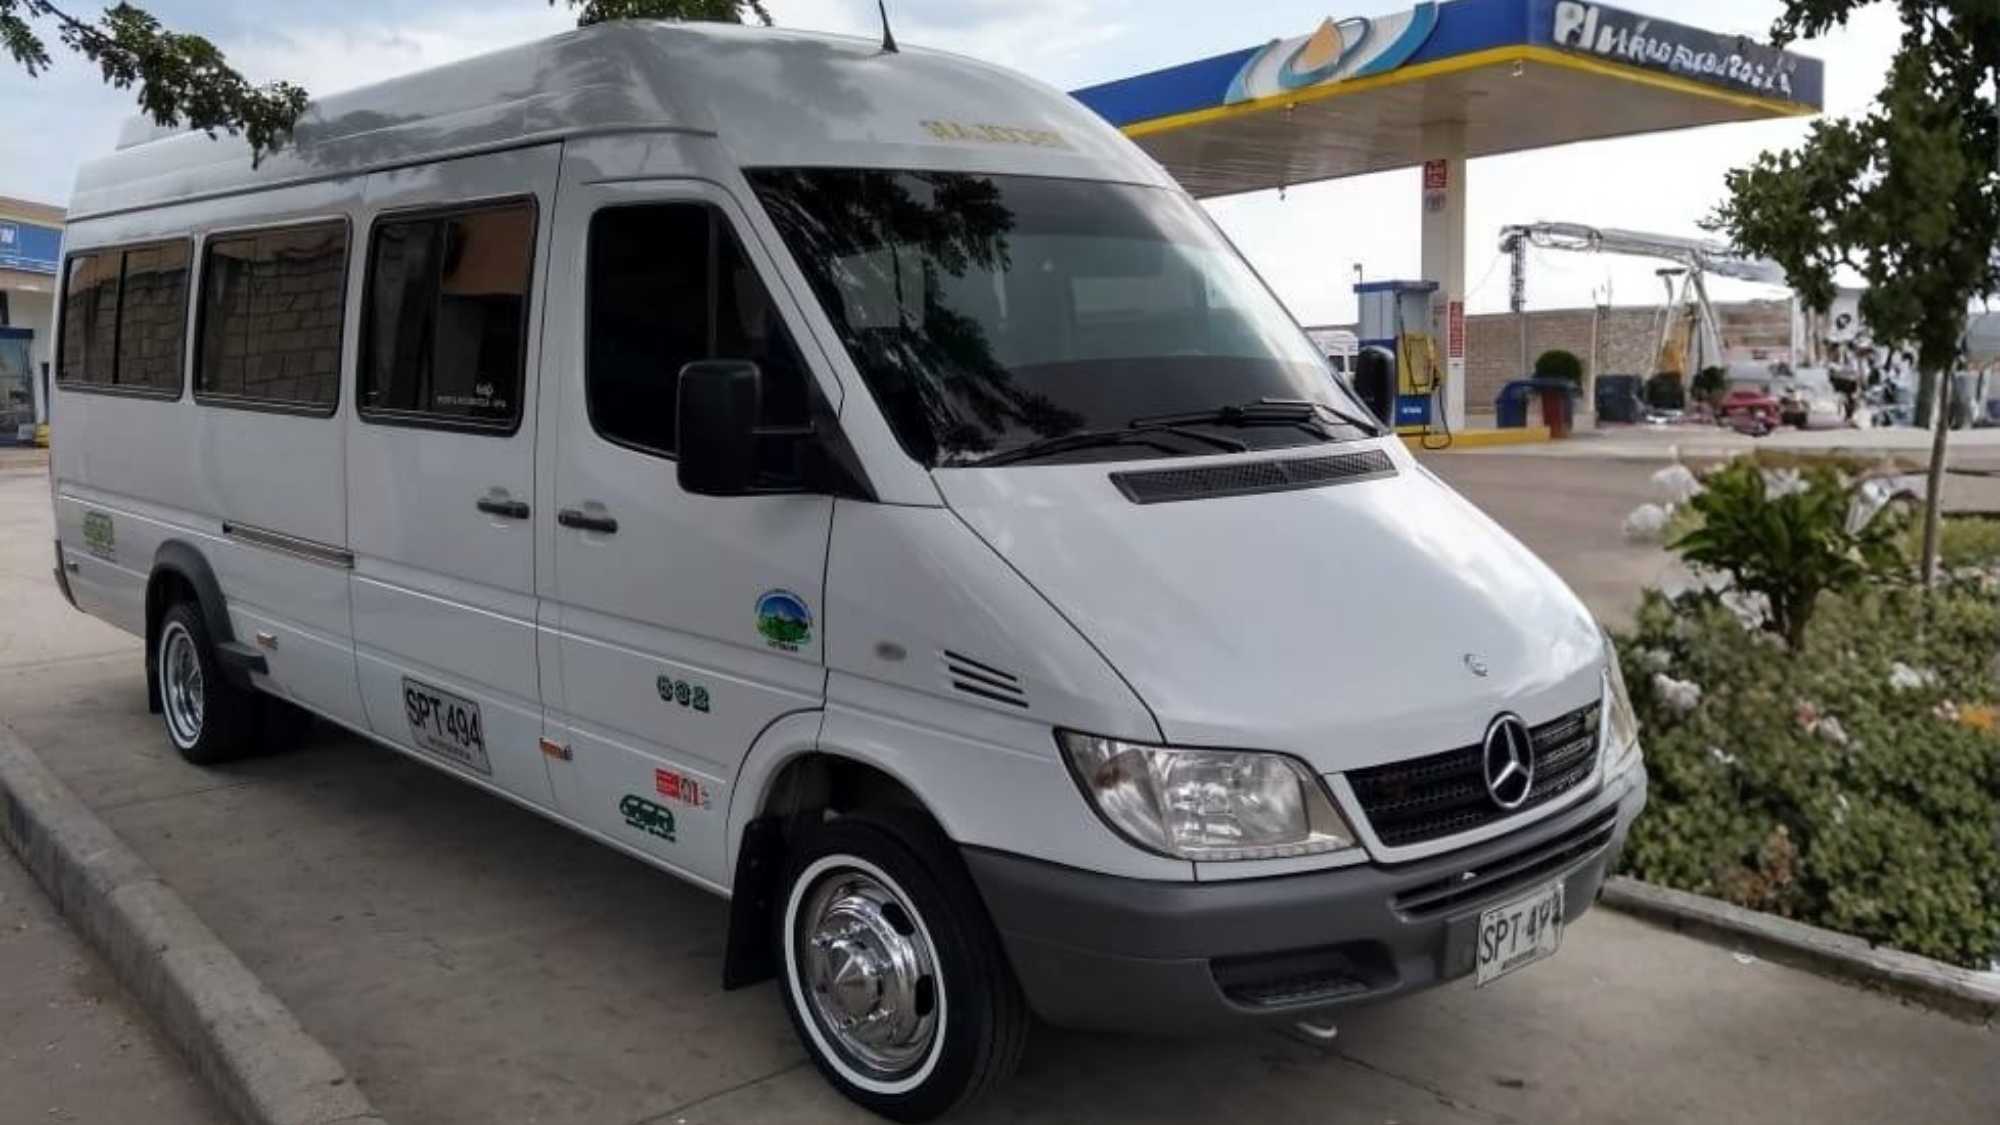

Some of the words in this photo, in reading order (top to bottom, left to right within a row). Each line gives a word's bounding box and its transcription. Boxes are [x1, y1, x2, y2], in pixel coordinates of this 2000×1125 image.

[406, 687, 442, 736] SPT
[447, 703, 482, 752] 494
[1481, 910, 1523, 965] SPT
